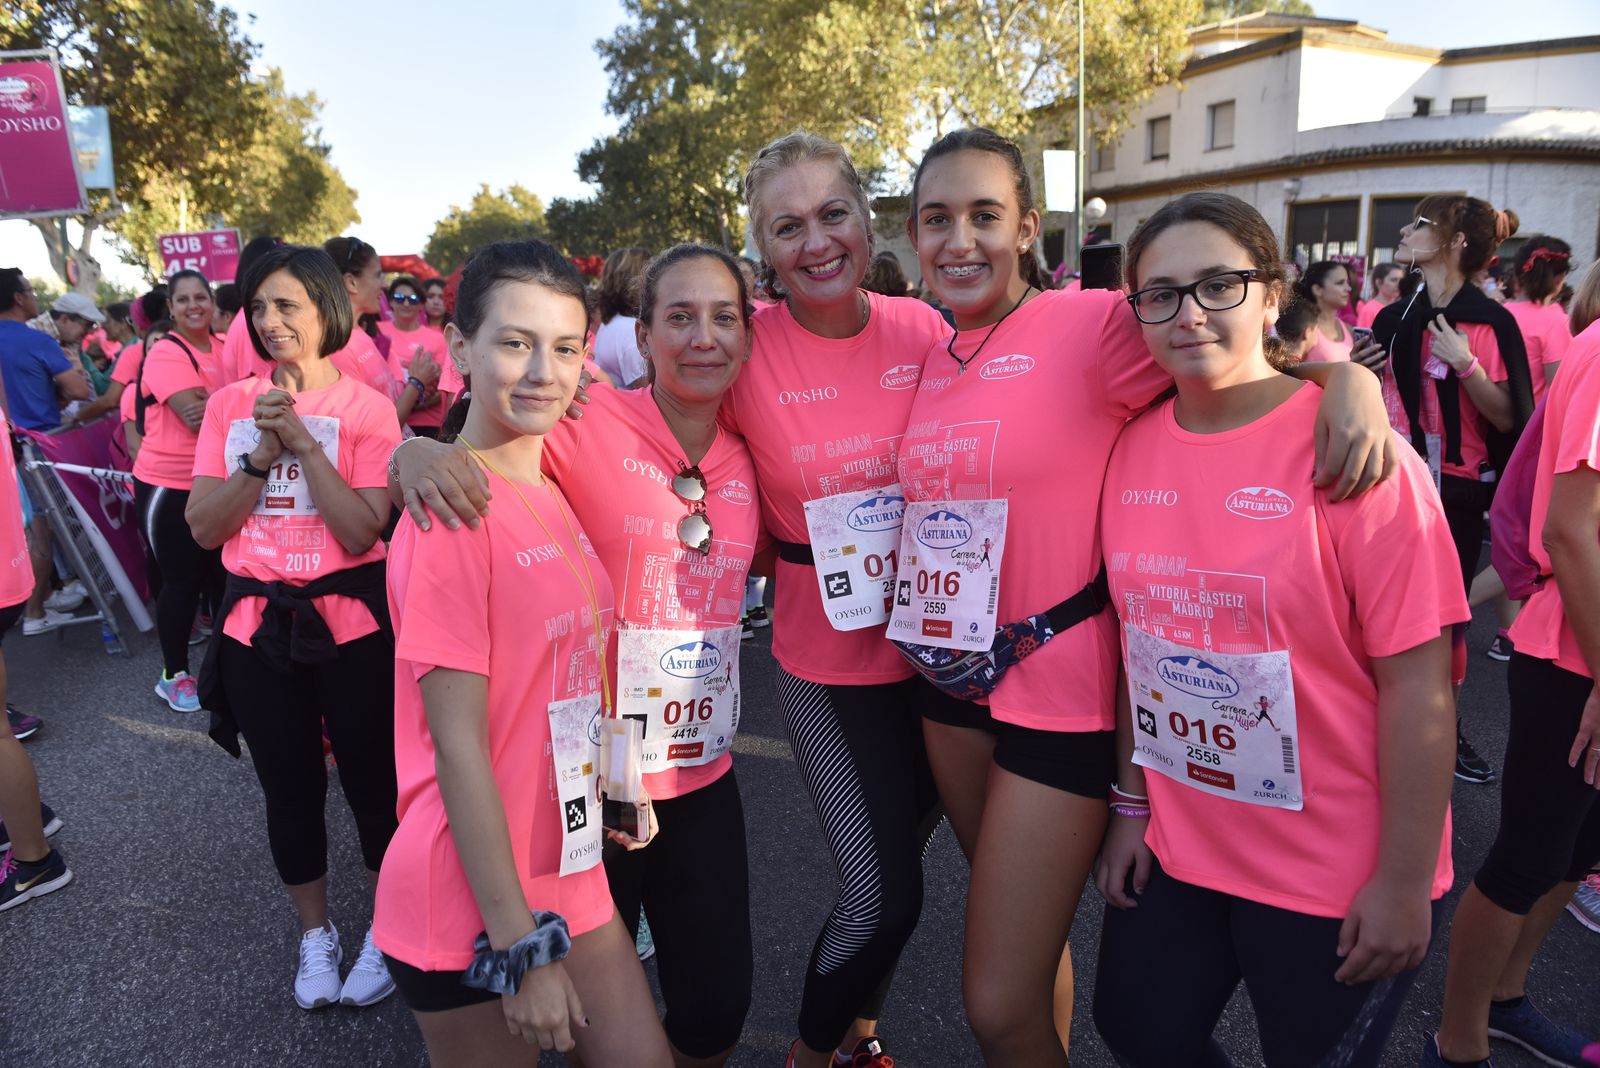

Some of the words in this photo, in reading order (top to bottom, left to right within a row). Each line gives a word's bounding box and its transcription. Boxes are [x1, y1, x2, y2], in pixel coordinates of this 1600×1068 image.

[162, 236, 202, 254] SUB
[983, 362, 1030, 377] ASTURIANA
[885, 372, 919, 387] ASTURIAN
[779, 386, 838, 405] OYSHO
[909, 443, 936, 456] VITORIA
[944, 438, 978, 452] GASTEIZ
[844, 456, 881, 473] VITORIA
[923, 453, 952, 466] MADRID
[271, 464, 299, 480] 16
[624, 458, 673, 488] OYSH
[266, 484, 288, 494] 3017
[1121, 489, 1178, 507] OYSHO
[1230, 496, 1288, 513] ASTURIANA
[623, 514, 655, 537] HOY
[854, 509, 905, 527] ASTURIAN
[275, 530, 321, 547] CHICAS
[921, 525, 968, 539] ASTURIANA
[286, 553, 321, 572] 2019
[645, 555, 657, 566] SE
[673, 547, 707, 565] VITORIA
[951, 549, 976, 559] Carrera
[689, 563, 724, 579] MADRID
[863, 550, 897, 577] 01
[1136, 552, 1187, 577] GANAN
[882, 580, 896, 592] 25
[917, 569, 961, 596] 016
[1125, 592, 1135, 605] SE
[1149, 585, 1190, 602] VITORIA
[1200, 591, 1244, 608] GASTEIZ
[834, 605, 872, 620] OYSHO
[923, 601, 946, 615] 2559
[1173, 602, 1214, 619] MADRID
[545, 610, 575, 641] HOY
[894, 619, 916, 631] OYSHO
[1153, 625, 1165, 638] VA
[963, 635, 985, 643] ZURICH
[665, 655, 718, 670] ASTURIANA
[1162, 664, 1233, 693] ASTURIANA
[663, 696, 713, 725] 016
[1211, 700, 1247, 716] Carrera
[1168, 711, 1237, 751] 016
[1233, 714, 1260, 731] Mujer
[671, 727, 699, 739] 4418
[641, 752, 657, 762] HO
[1142, 744, 1174, 767] OYSHO
[1186, 745, 1221, 766] 2558
[1199, 771, 1229, 784] Santander
[1253, 790, 1287, 800] ZURICH
[569, 839, 599, 861] OYSHO
